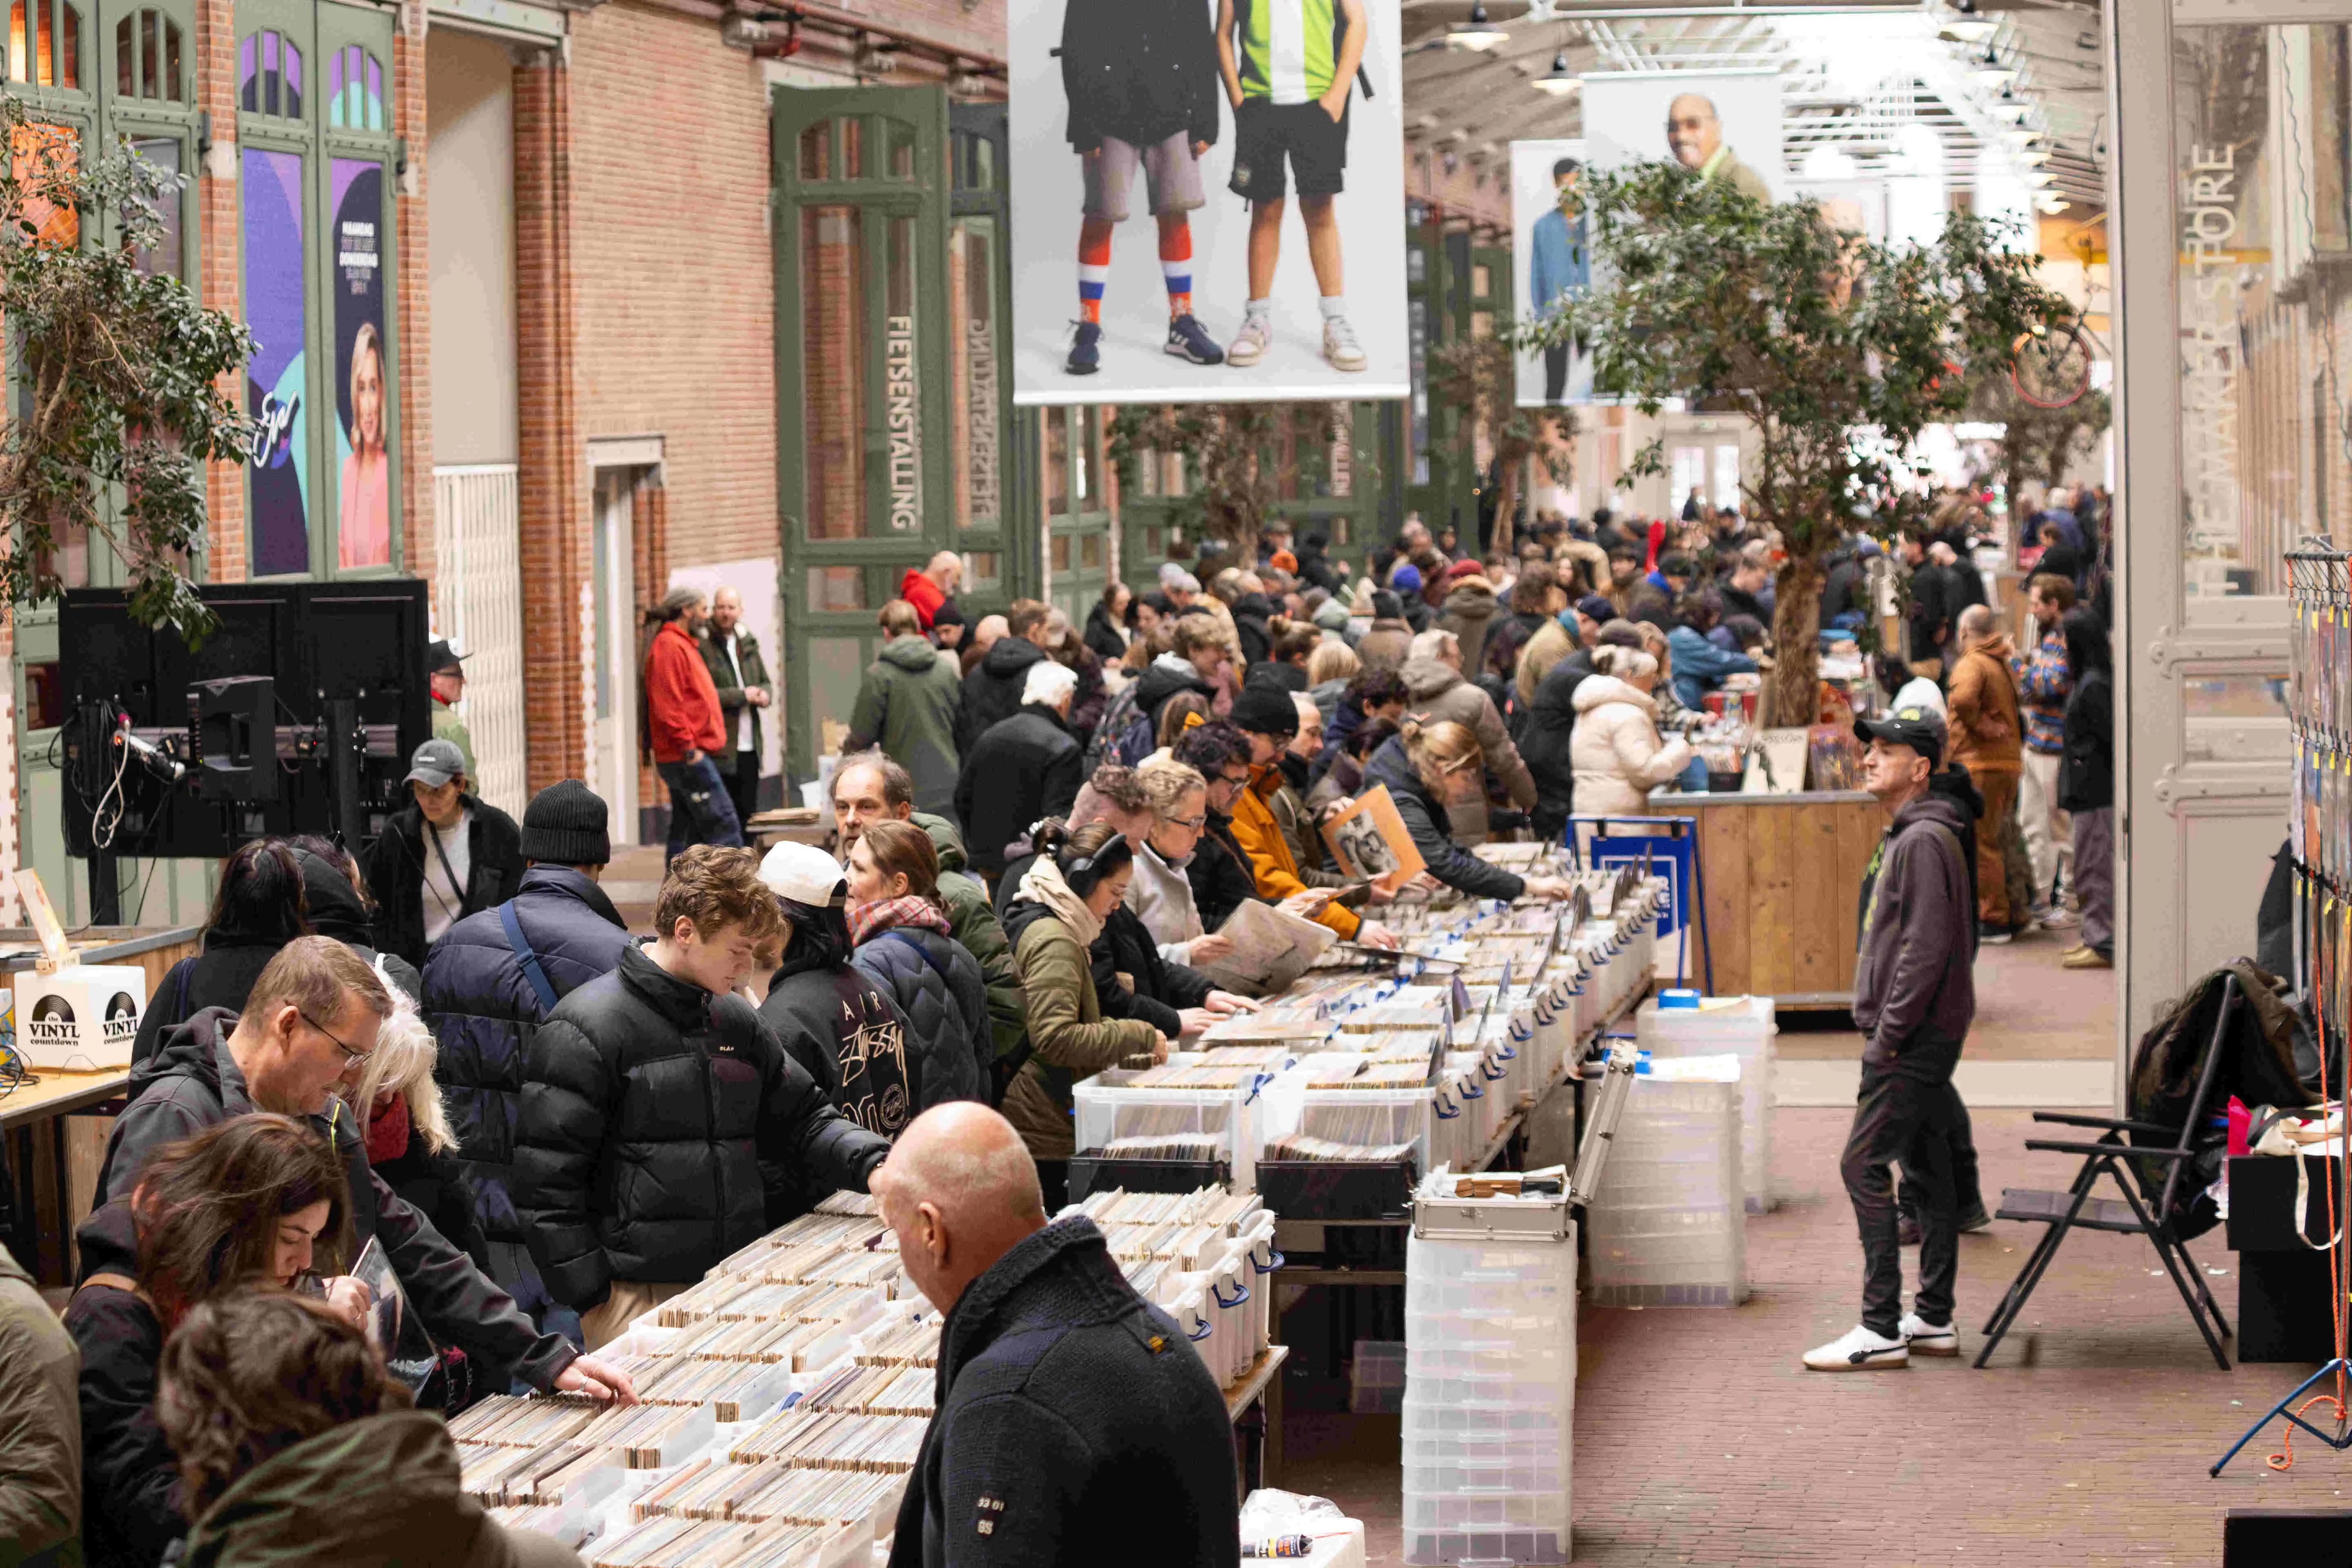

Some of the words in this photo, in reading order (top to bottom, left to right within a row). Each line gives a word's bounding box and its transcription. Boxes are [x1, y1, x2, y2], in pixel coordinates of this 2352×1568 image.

[2191, 144, 2236, 300] STORE
[2196, 320, 2238, 481] MAKER
[888, 316, 916, 530] FIETSENSTALLING
[842, 991, 882, 1021] AIR
[29, 1023, 80, 1038] VINYL
[103, 1019, 138, 1036] VINYL
[31, 1038, 78, 1046] countdown
[104, 1034, 135, 1045] countdow
